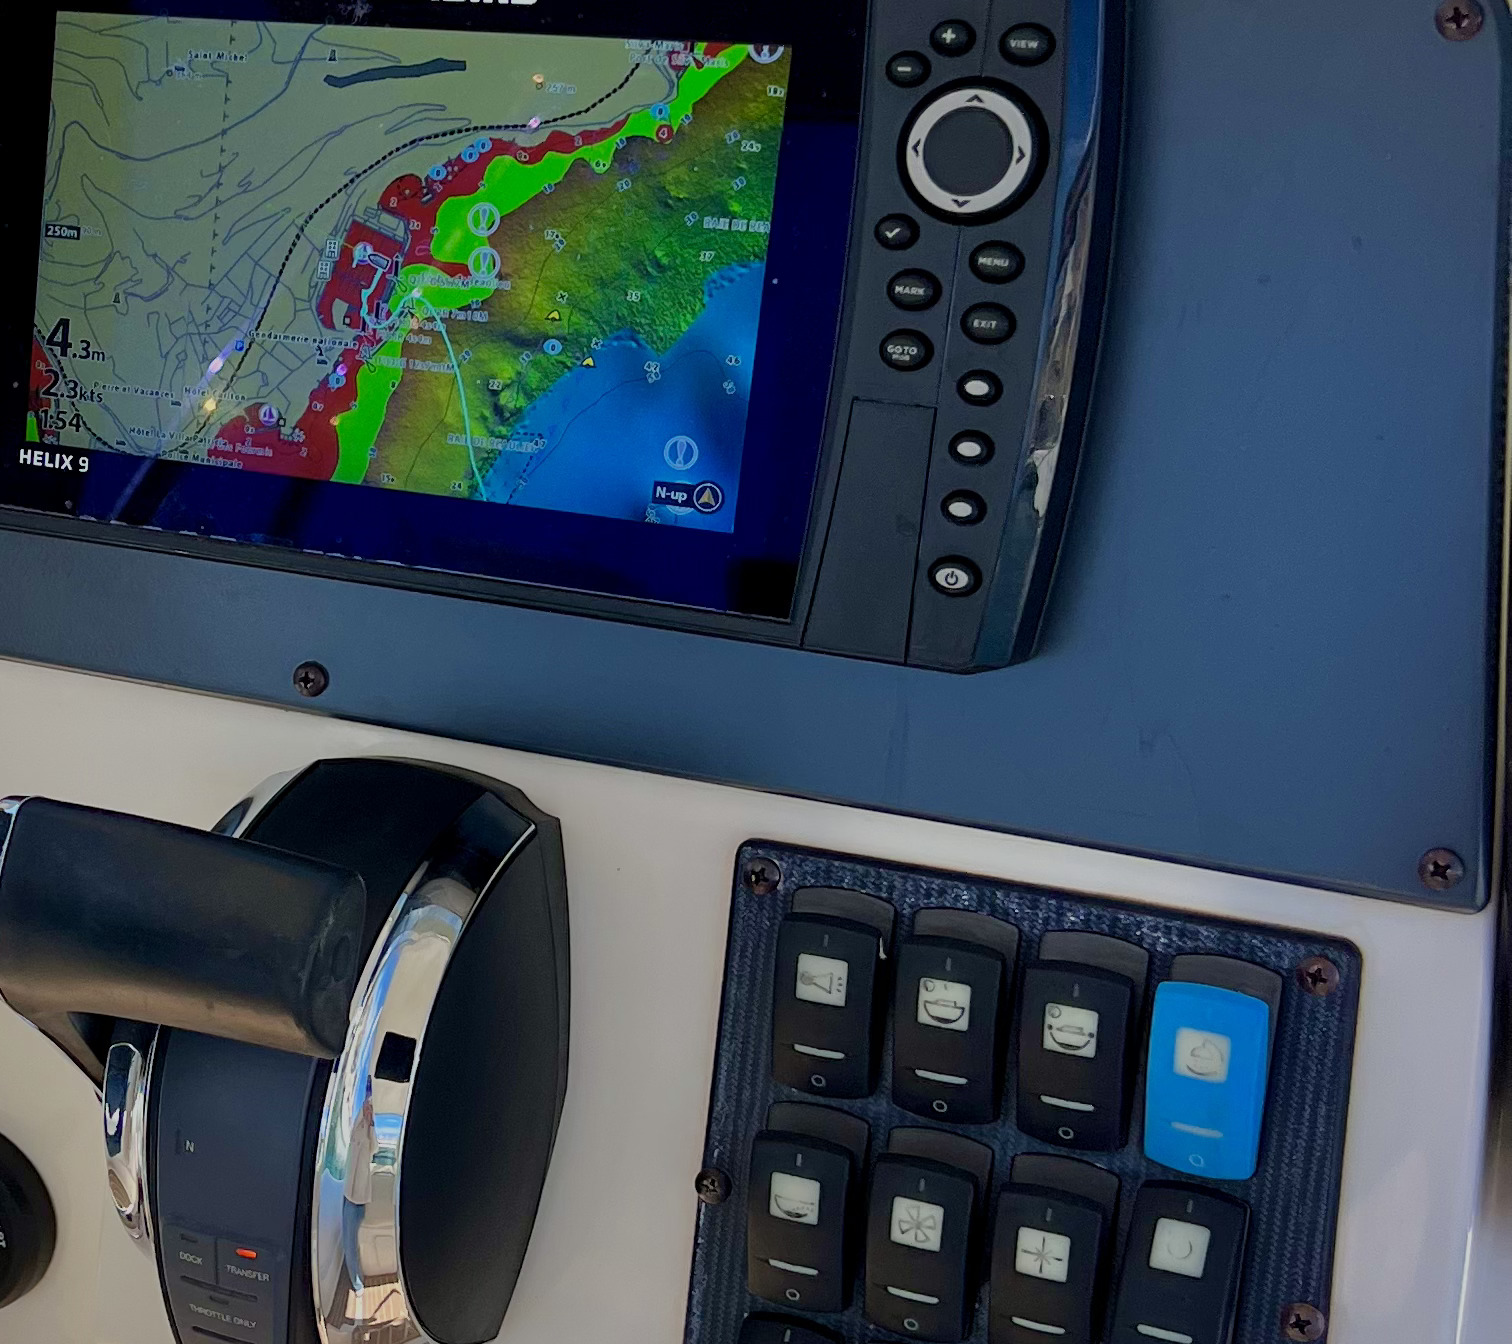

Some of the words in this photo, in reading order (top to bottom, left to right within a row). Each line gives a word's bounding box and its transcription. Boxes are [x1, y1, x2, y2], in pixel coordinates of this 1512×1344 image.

[1009, 38, 1039, 49] VIEW
[47, 225, 78, 238] 250m
[978, 256, 1009, 267] MENU
[894, 285, 925, 296] MARK
[973, 319, 997, 329] EXIT
[46, 318, 106, 361] 4.3m
[41, 368, 104, 404] 2.3kts
[41, 408, 82, 433] 1:54
[19, 448, 73, 471] HELIX
[78, 456, 89, 472] 9
[655, 486, 687, 503] N-up
[185, 1139, 195, 1153] N
[179, 1250, 203, 1266] DOCK
[225, 1263, 270, 1283] TRANSFER
[189, 1303, 232, 1323] THROTTLE
[233, 1315, 256, 1329] ONLY
